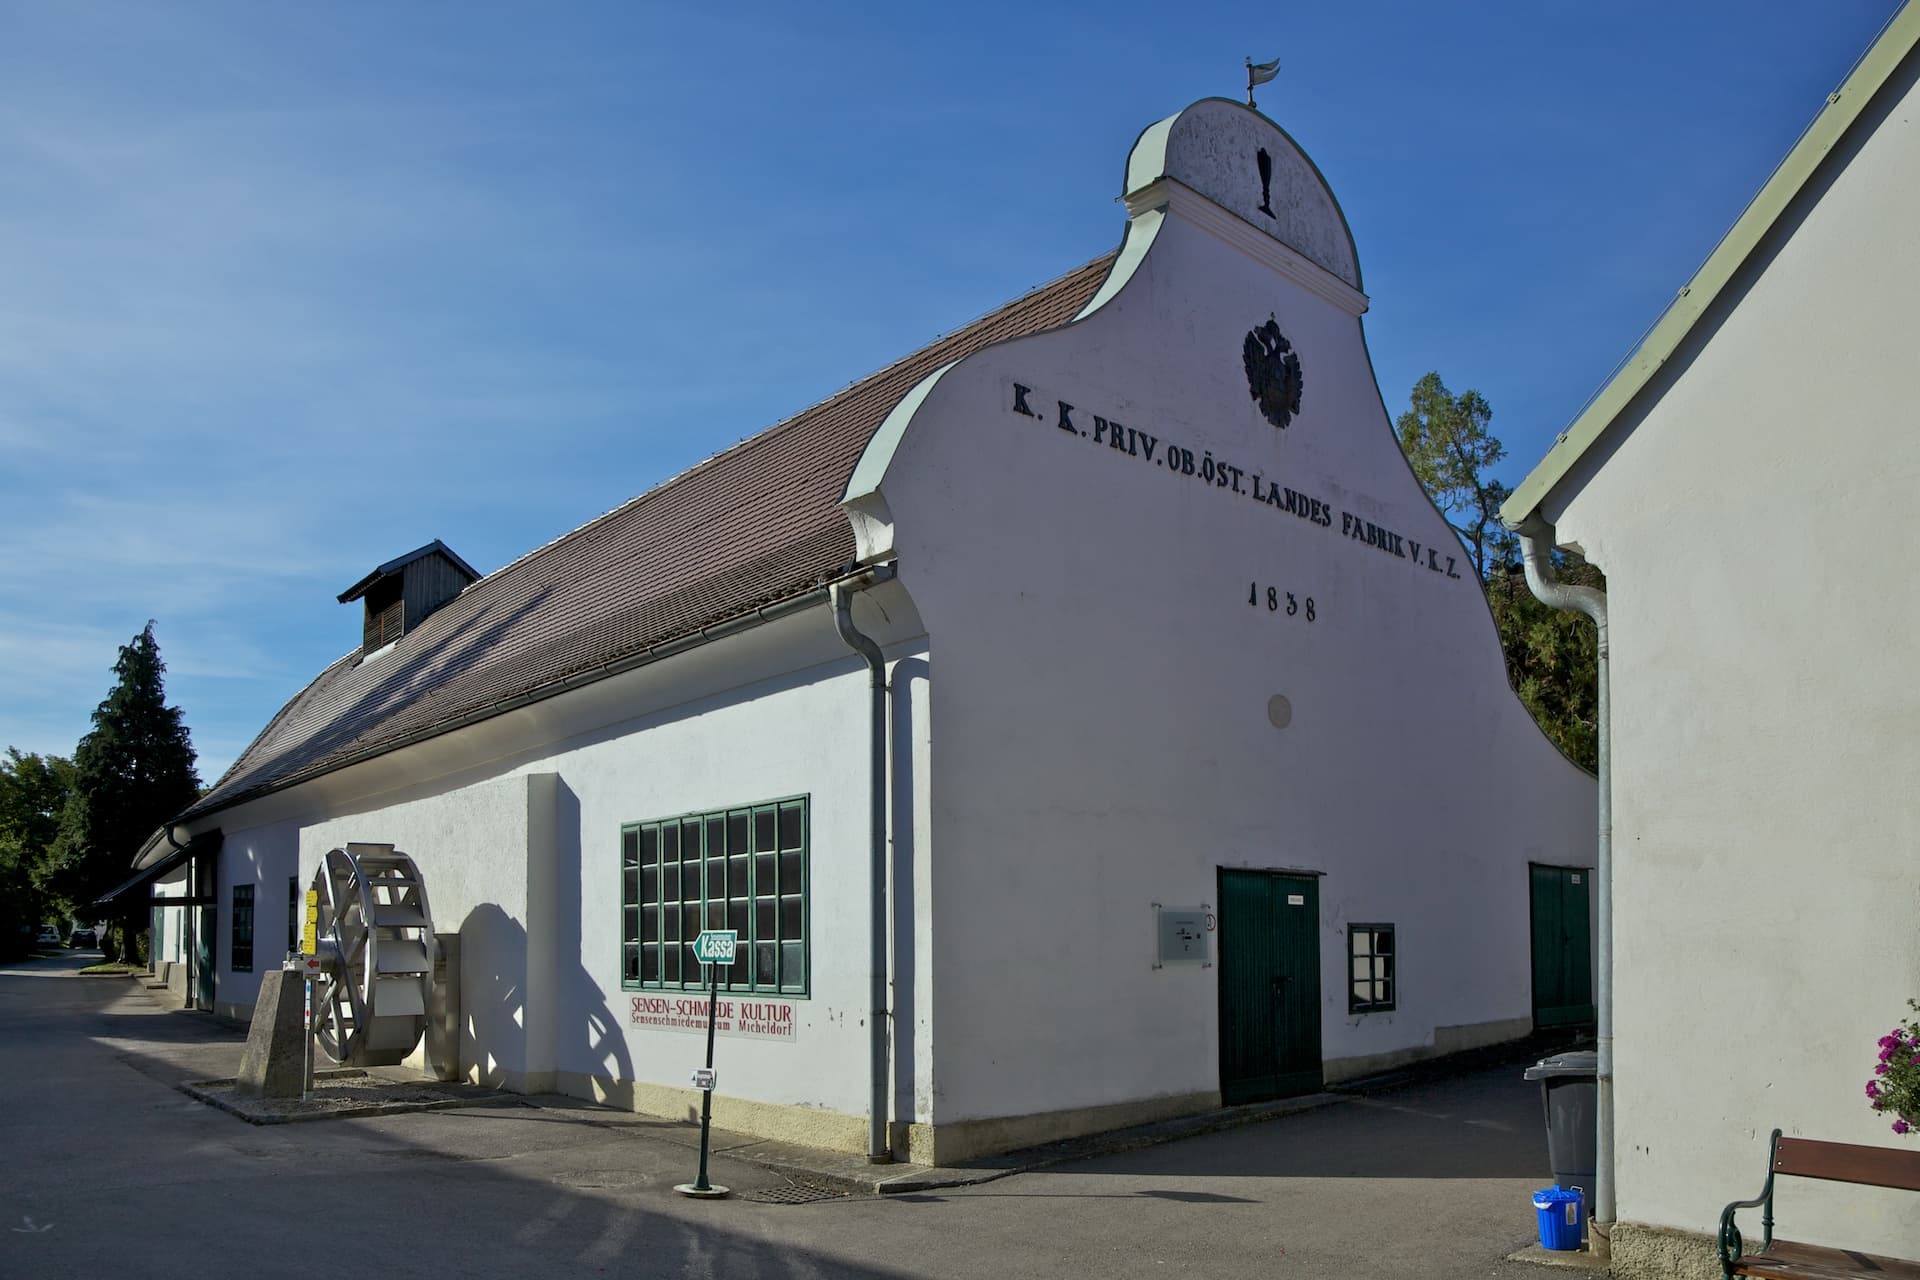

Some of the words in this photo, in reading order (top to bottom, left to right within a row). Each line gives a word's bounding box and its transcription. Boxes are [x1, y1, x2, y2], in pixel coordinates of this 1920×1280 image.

[1013, 382, 1043, 421] K.
[1058, 400, 1087, 437] K.
[1093, 415, 1162, 466] PRIV.
[1252, 475, 1332, 527] LANDES
[1342, 511, 1406, 558] FABRIK
[1248, 581, 1316, 622] 1838
[701, 935, 734, 958] Kassa
[741, 1002, 791, 1022] KULTUR
[631, 1013, 730, 1031] Sensenschmiedemuum
[739, 1020, 792, 1035] Micheldorf
